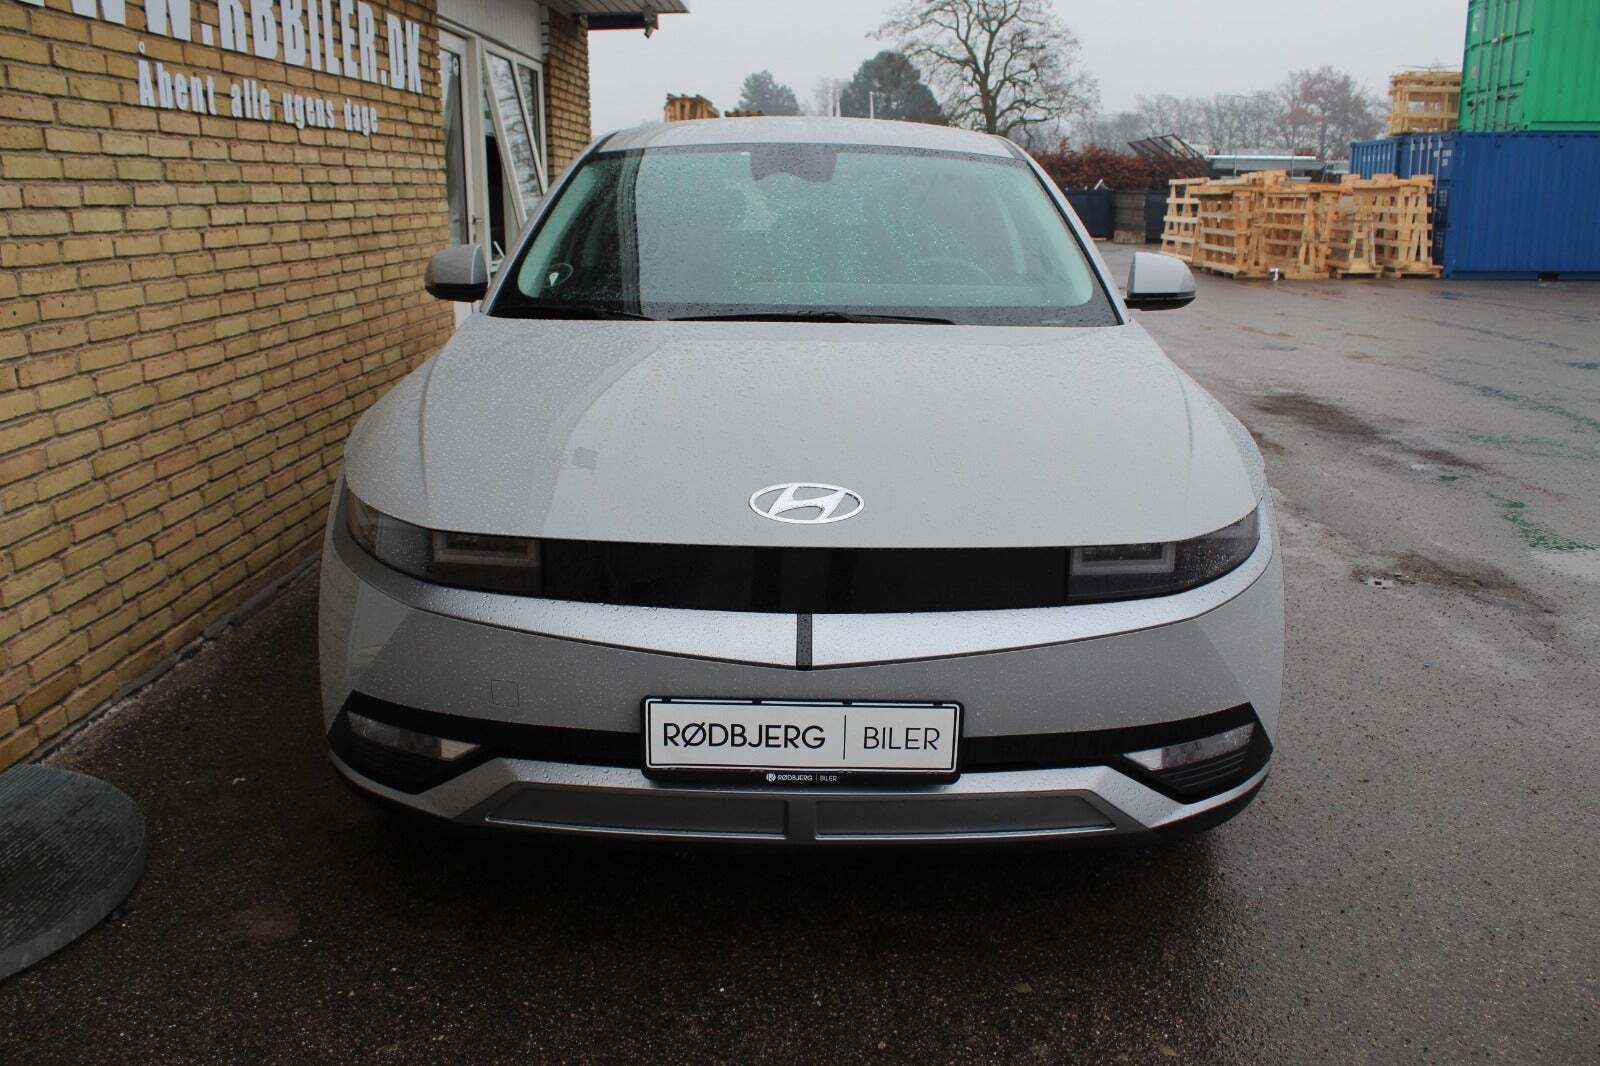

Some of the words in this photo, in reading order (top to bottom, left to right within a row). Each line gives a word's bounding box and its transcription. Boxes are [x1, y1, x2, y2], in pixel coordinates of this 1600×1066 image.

[138, 40, 217, 115] Åbent
[230, 78, 271, 121] alle
[282, 92, 336, 130] ugens
[343, 97, 379, 137] dage
[663, 722, 826, 750] RØDBJERG
[863, 726, 941, 750] BILER
[777, 774, 813, 782] RØDBJERG
